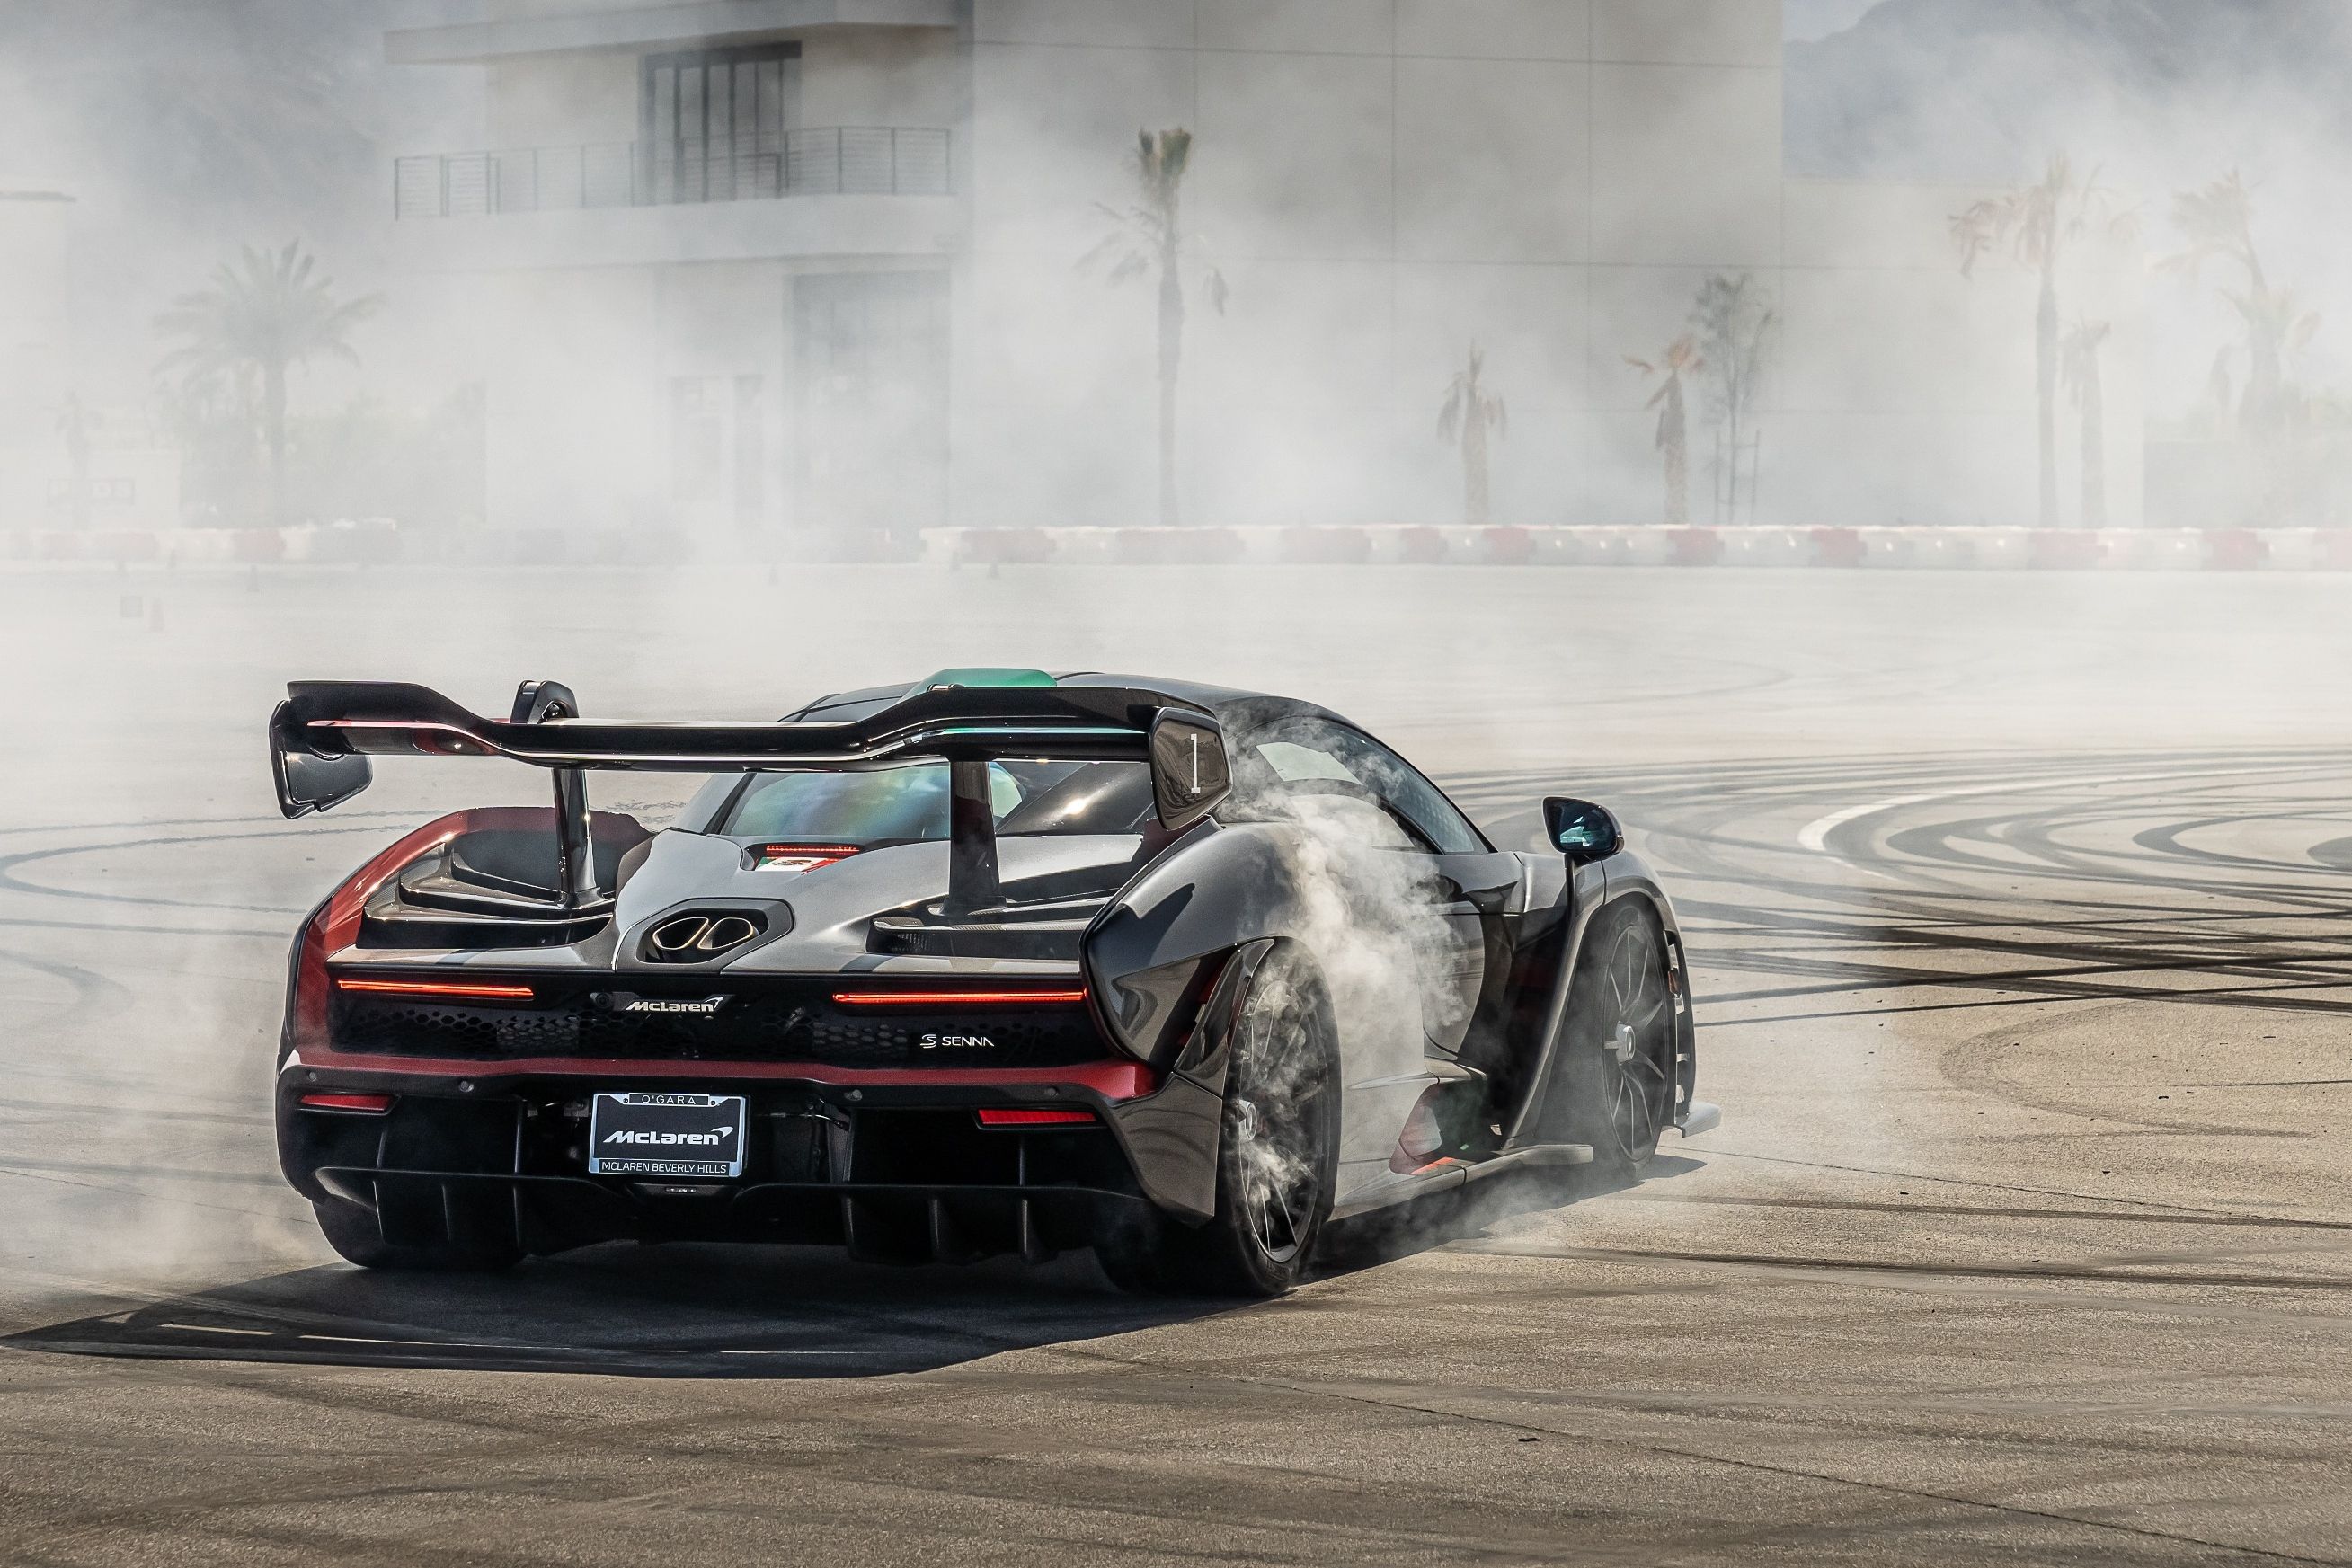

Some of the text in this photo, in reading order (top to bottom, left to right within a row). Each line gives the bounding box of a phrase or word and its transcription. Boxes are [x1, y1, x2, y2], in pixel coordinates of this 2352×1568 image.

[626, 1001, 714, 1012] McLaren
[941, 1036, 995, 1047] SENNA
[642, 1094, 697, 1105] O'GARA
[603, 1130, 719, 1146] McLaren
[601, 1161, 727, 1174] MCLAREN BEVERLY HILLS
